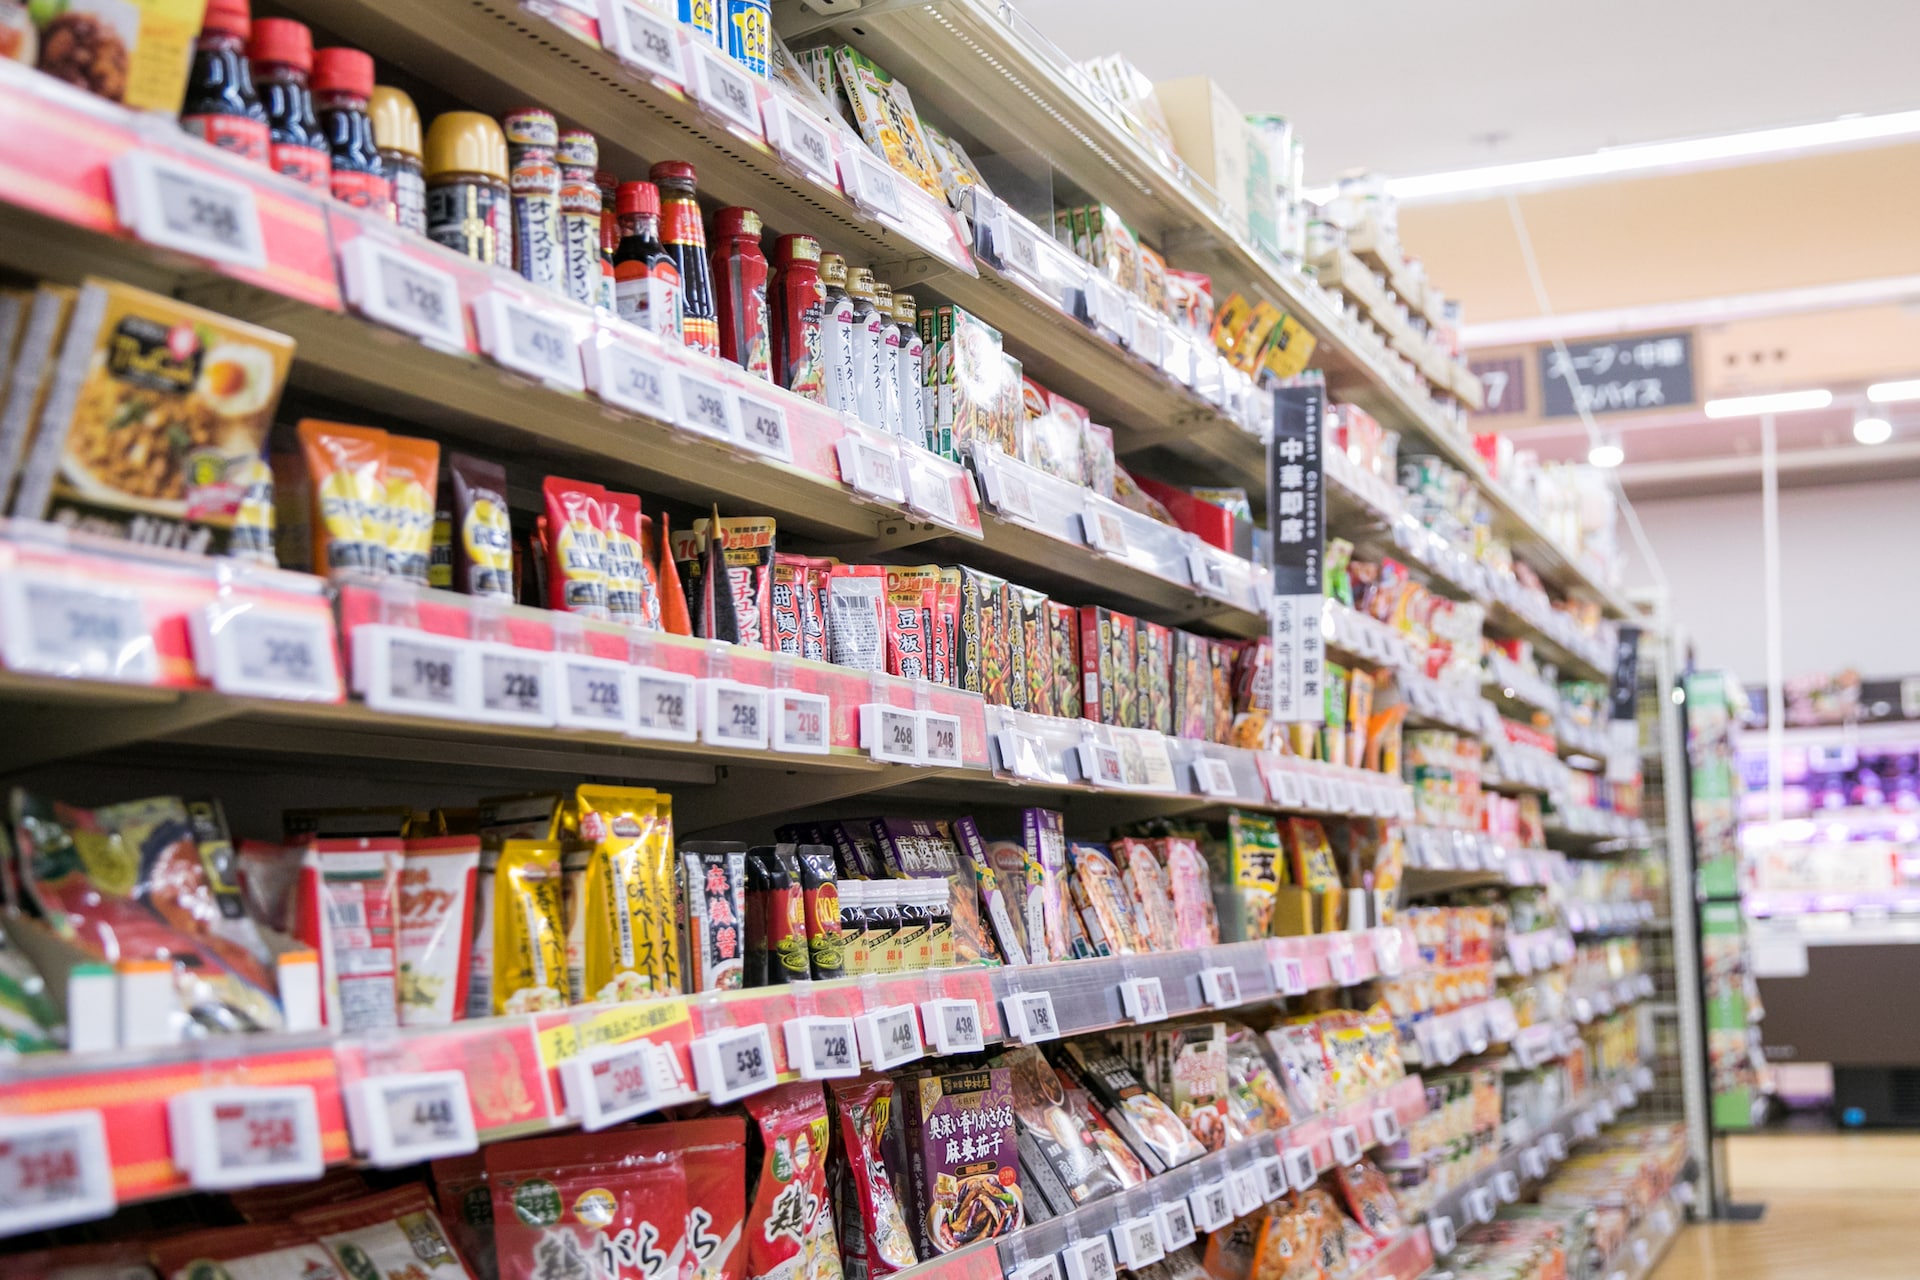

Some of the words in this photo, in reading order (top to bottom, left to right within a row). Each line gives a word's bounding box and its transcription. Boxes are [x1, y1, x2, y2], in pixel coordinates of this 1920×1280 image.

[721, 78, 745, 109] 158
[629, 368, 659, 396] 278
[697, 393, 724, 420] 398
[756, 416, 780, 441] 428
[1279, 437, 1304, 543] 中華即席
[1306, 470, 1319, 539] Chinese
[897, 609, 923, 680] 豆板醤
[413, 658, 453, 688] 198
[503, 671, 539, 699] 228
[587, 680, 619, 705] 228
[656, 693, 684, 717] 228
[732, 703, 757, 727] 258
[798, 712, 820, 734] 218
[893, 725, 913, 746] 268
[936, 729, 954, 749] 248
[1104, 758, 1119, 776] 128
[705, 863, 737, 959] 麻辣醤
[955, 1015, 973, 1035] 438
[1033, 1007, 1048, 1026] 158
[824, 1036, 848, 1057] 228
[891, 1023, 912, 1045] 448
[736, 1047, 763, 1072] 538
[614, 1065, 643, 1093] 308
[963, 1075, 991, 1090] 中村屋
[412, 1100, 454, 1128] 448
[944, 1132, 1004, 1165] 麻婆茄子
[1090, 1252, 1107, 1272] 258
